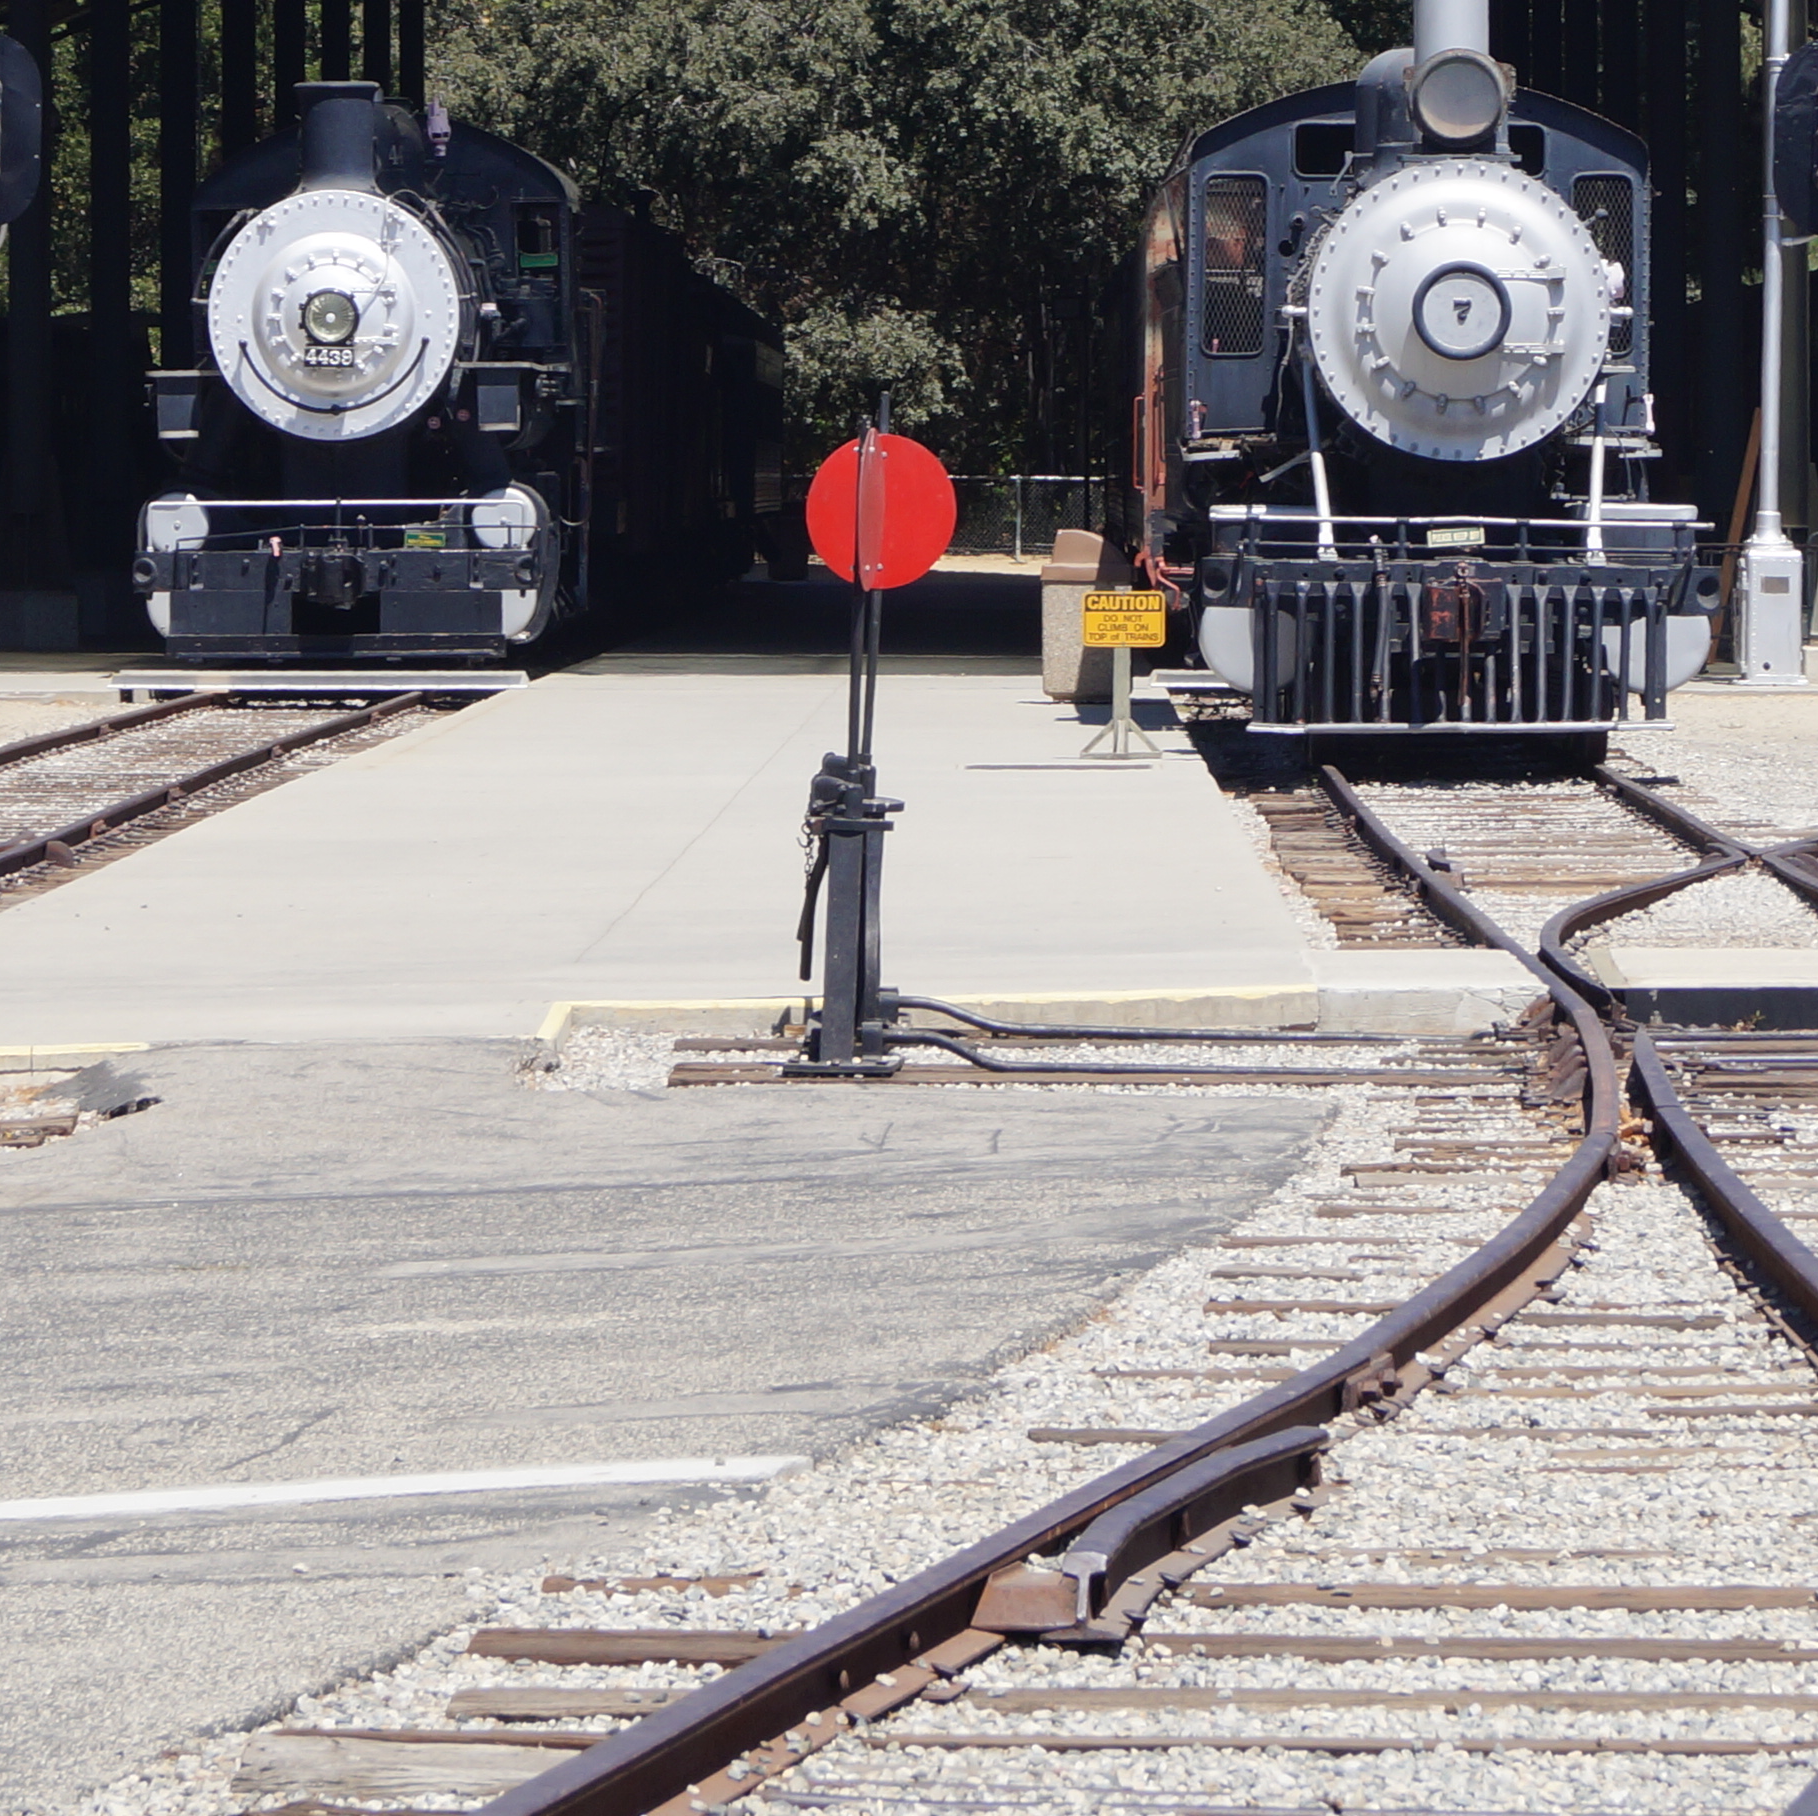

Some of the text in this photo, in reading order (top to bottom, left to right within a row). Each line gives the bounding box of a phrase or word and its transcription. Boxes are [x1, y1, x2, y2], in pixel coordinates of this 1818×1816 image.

[1453, 297, 1472, 326] 7
[305, 348, 353, 366] 4439
[1086, 595, 1160, 611] CAUTION
[1103, 614, 1144, 623] DO NOT
[1097, 623, 1149, 632] CLIMB ON
[1088, 632, 1159, 641] TOP of TRAINS
